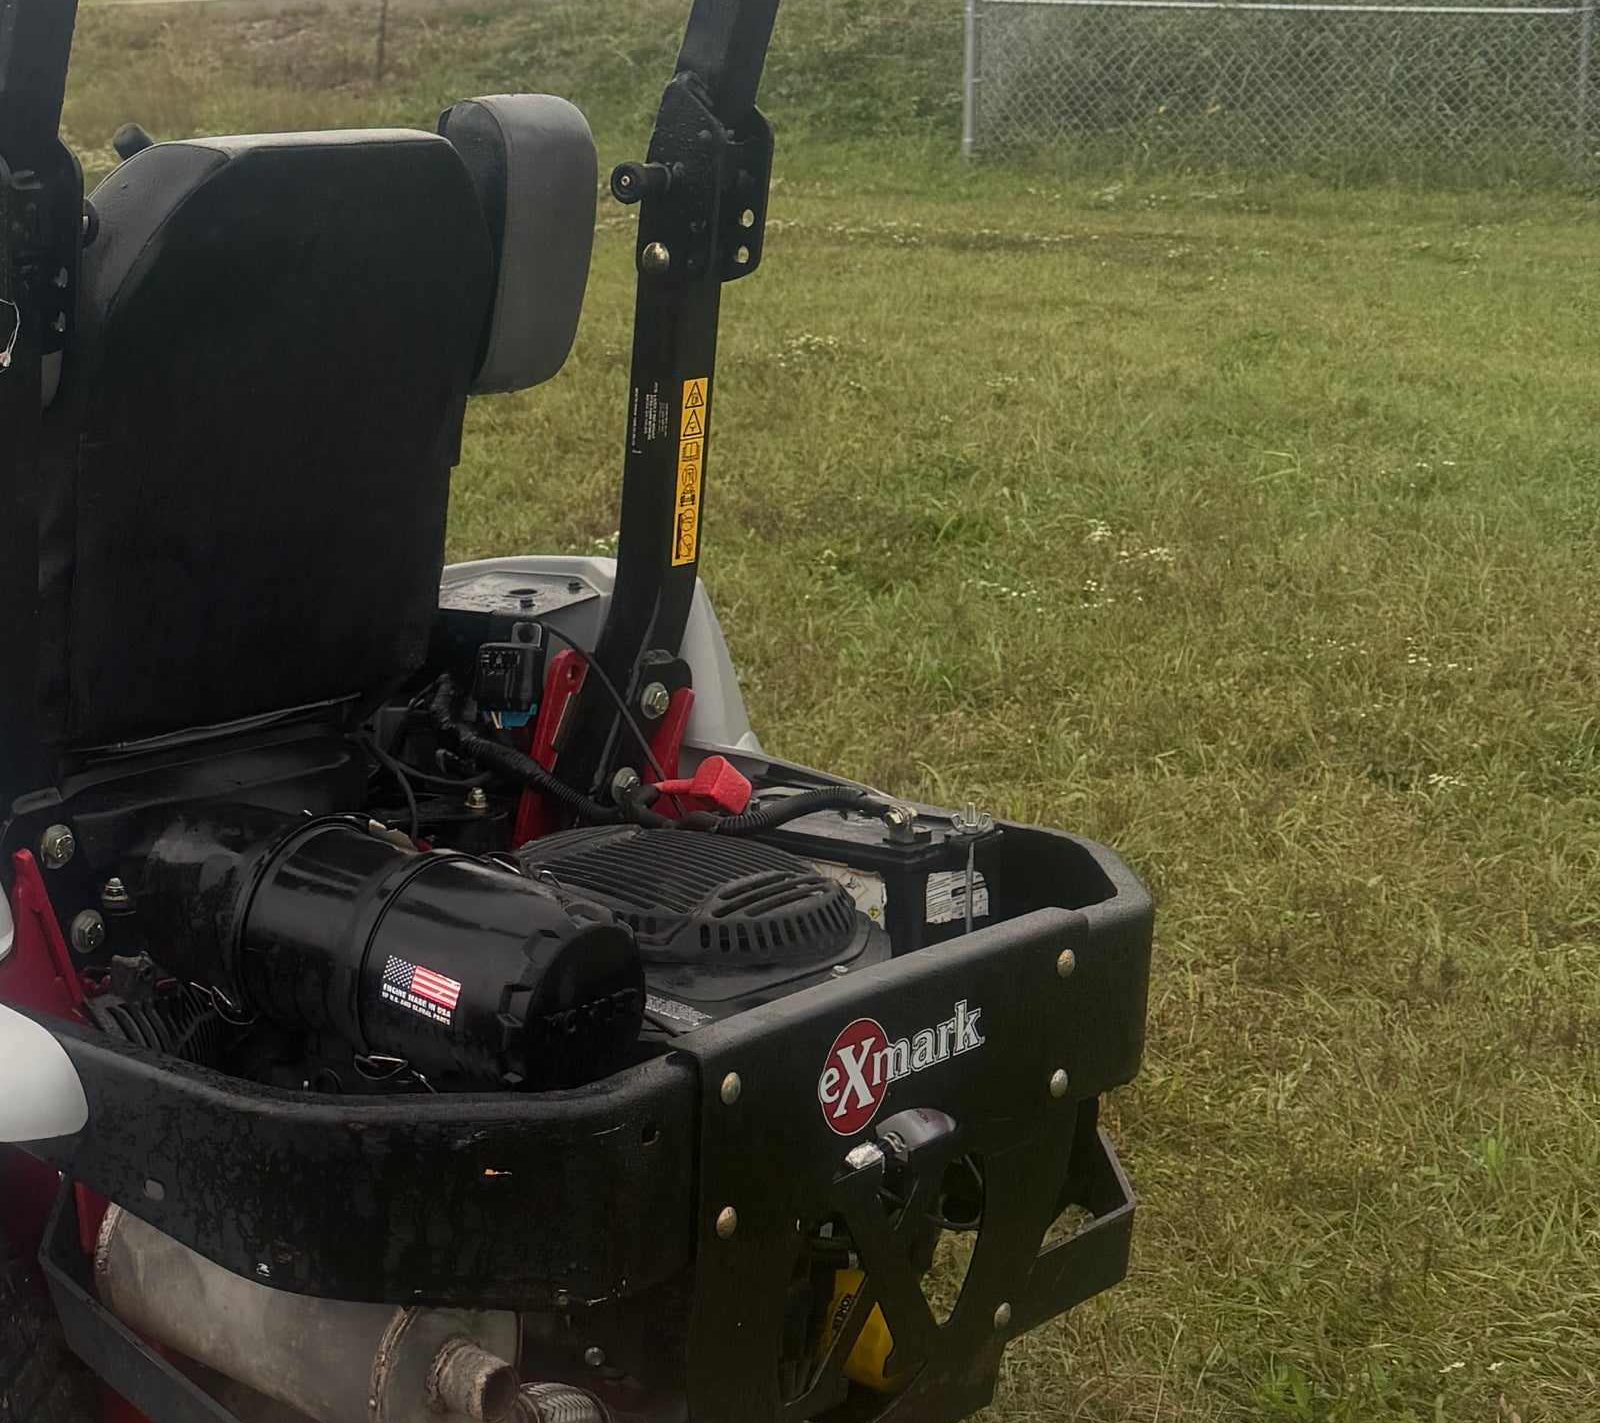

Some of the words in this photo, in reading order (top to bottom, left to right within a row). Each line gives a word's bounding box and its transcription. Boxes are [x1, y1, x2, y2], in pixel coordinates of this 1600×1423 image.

[382, 983, 407, 999] ENGINE
[408, 993, 427, 1008] MADE
[428, 1002, 436, 1012] IN
[437, 1006, 451, 1018] USA
[400, 999, 412, 1009] AND
[433, 1012, 451, 1026] PARTS
[819, 1000, 983, 1119] eXmark
[832, 1293, 855, 1332] KOHLE
